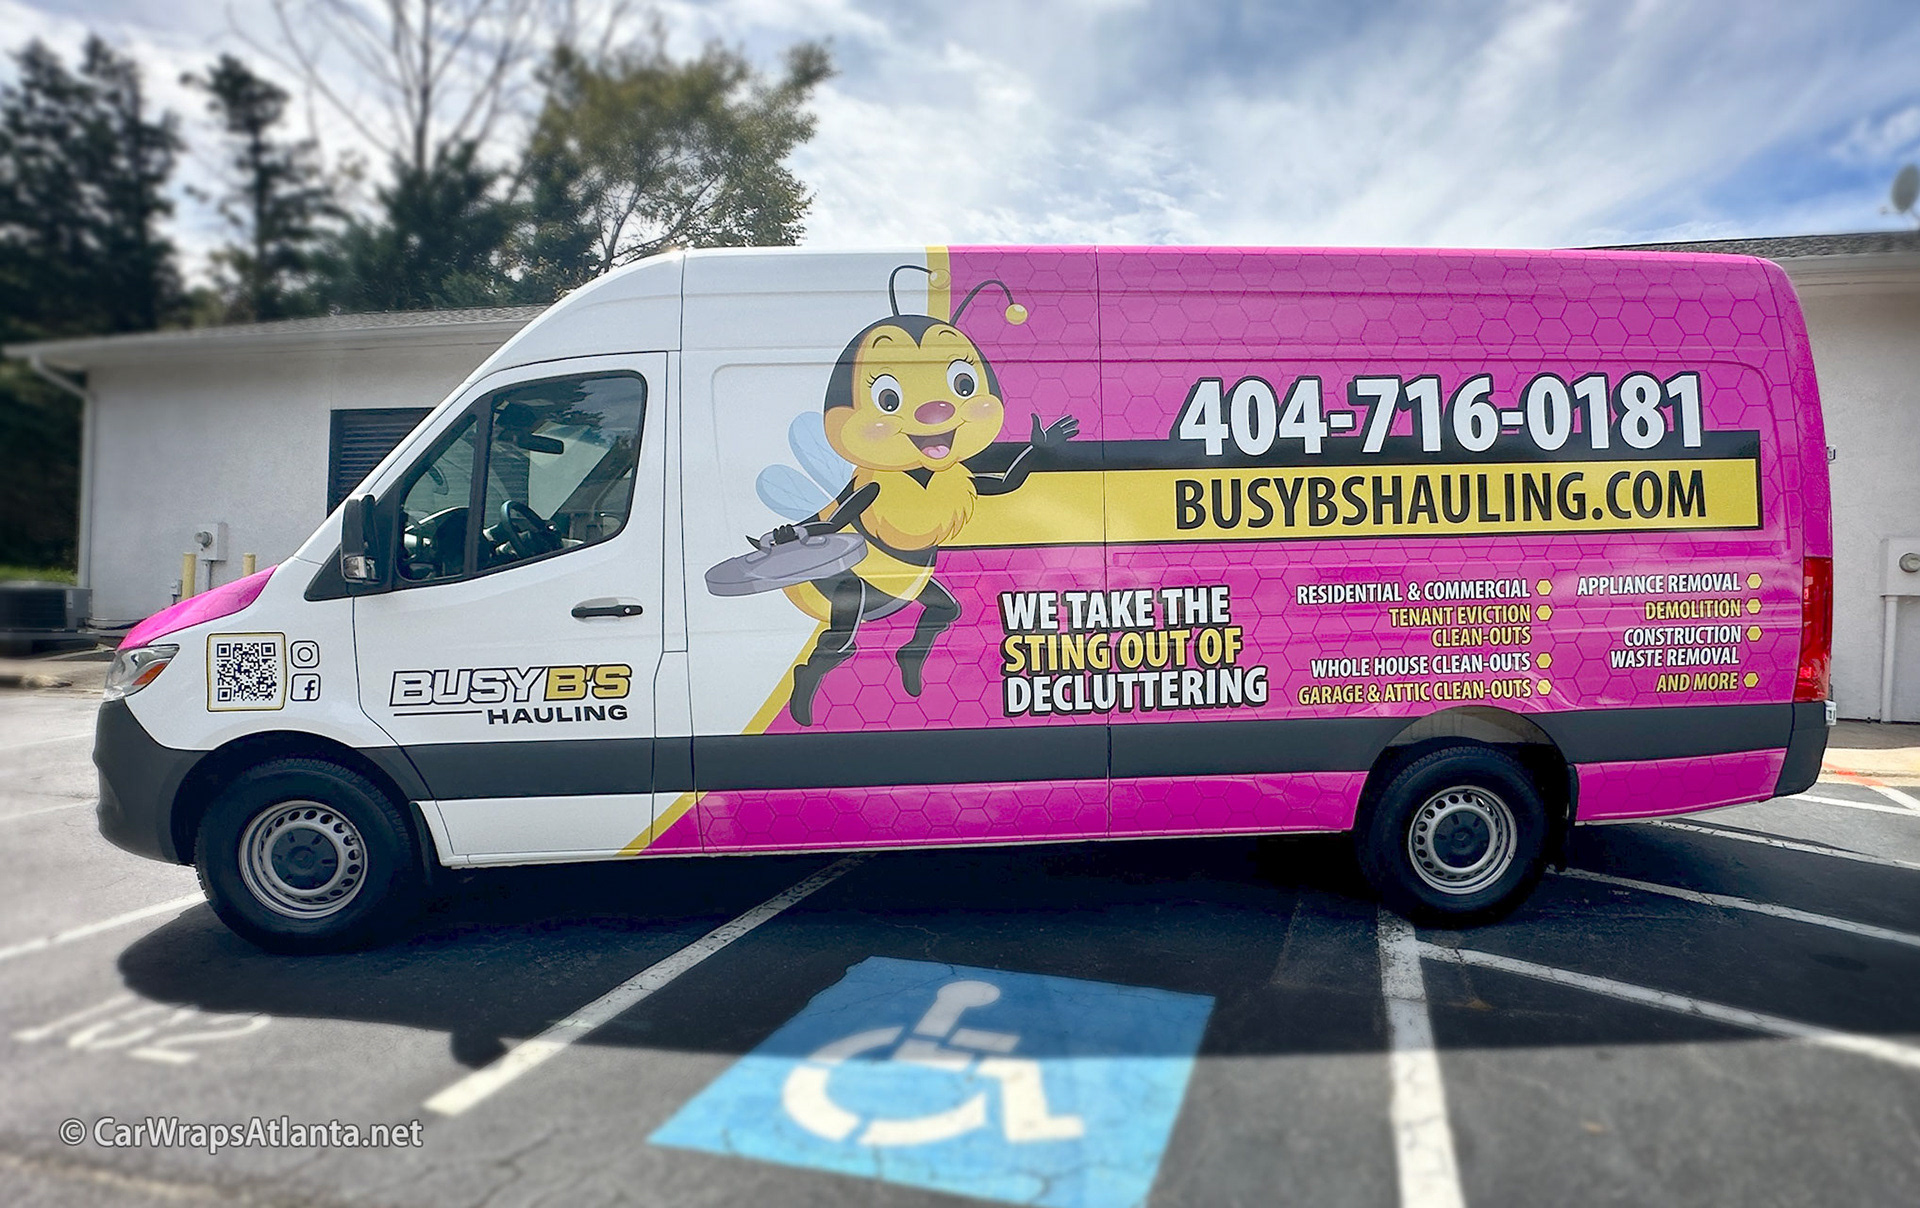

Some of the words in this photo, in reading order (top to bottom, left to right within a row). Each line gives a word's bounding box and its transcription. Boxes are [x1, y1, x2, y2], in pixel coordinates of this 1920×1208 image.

[1179, 375, 1702, 456] 404-716-0181
[1175, 469, 1707, 530] BUSYBSHAULING.COM
[1297, 583, 1402, 604] RESIDENTIAL
[1408, 583, 1420, 601] &
[1424, 580, 1530, 600] COMMERCIAL
[1577, 575, 1664, 596] APPLIANCE
[1668, 573, 1741, 593] REMOVAL
[1002, 592, 1058, 630] WE
[1066, 590, 1154, 629] TAKE
[1162, 586, 1230, 625] THE
[1389, 606, 1453, 626] TENANT
[1457, 605, 1531, 625] EVICTION
[1645, 599, 1741, 619] DEMOLITION
[1432, 627, 1531, 647] CLEAN-OUTS
[1623, 625, 1742, 647] CONSTRUCTION
[1005, 634, 1111, 671] STING
[1120, 630, 1190, 668] OUT
[1198, 627, 1242, 664] OF
[1611, 649, 1662, 668] WASTE
[1666, 646, 1740, 666] REMOVAL
[1312, 658, 1370, 678] WHOLE
[1374, 656, 1428, 676] HOUSE
[1432, 653, 1531, 673] CLEAN-OUTS
[1007, 668, 1268, 713] DECLUTTERING
[1298, 685, 1363, 705] GARAGE
[1366, 684, 1380, 702] &
[1384, 682, 1430, 702] ATTIC
[1433, 679, 1532, 700] CLEAN-OUTS
[1656, 675, 1690, 692] AND
[1693, 672, 1738, 691] MORE
[488, 705, 628, 724] HAULING
